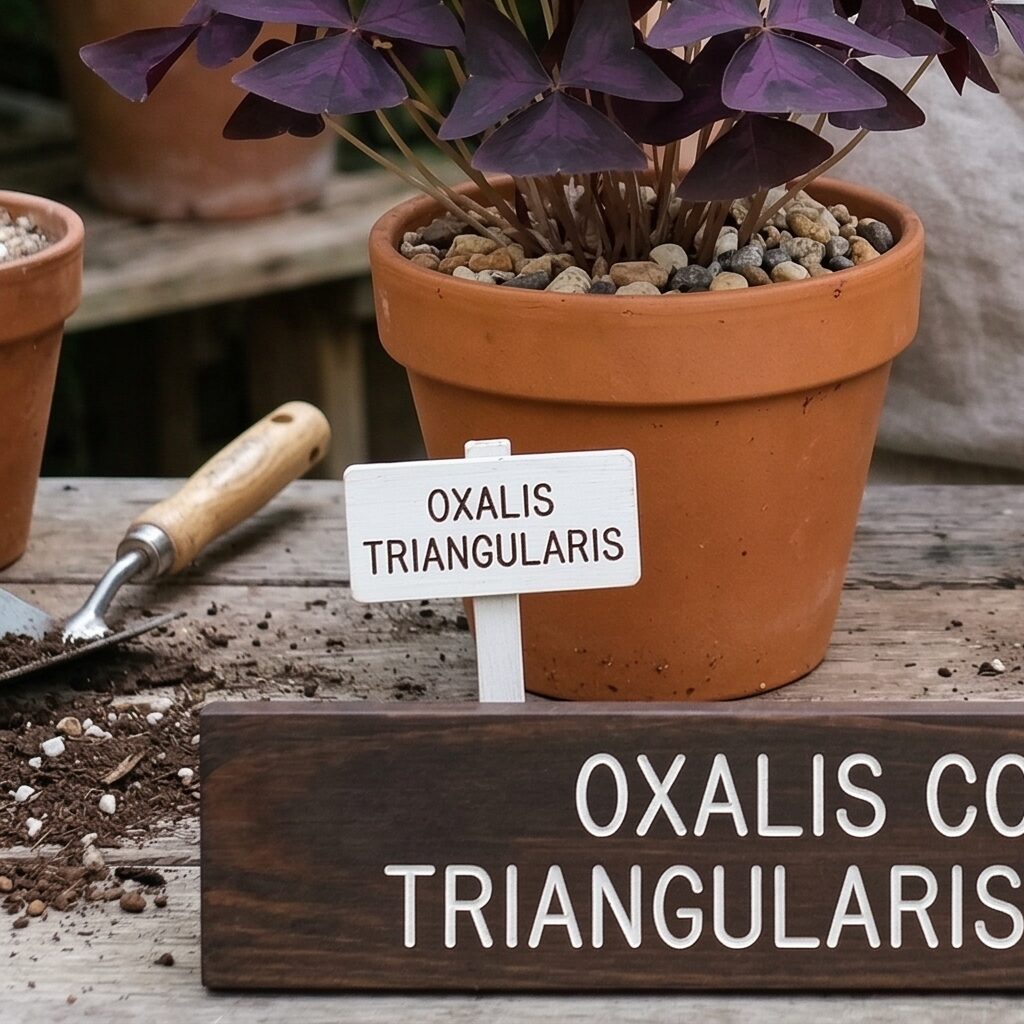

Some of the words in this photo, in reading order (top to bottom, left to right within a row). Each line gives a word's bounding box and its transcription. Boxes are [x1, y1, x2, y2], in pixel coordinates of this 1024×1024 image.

[427, 482, 555, 523] OXALIS
[362, 526, 624, 576] TRIANGULARIS
[575, 753, 887, 838] OXALIS
[384, 864, 1024, 950] TRIANGULARIS
